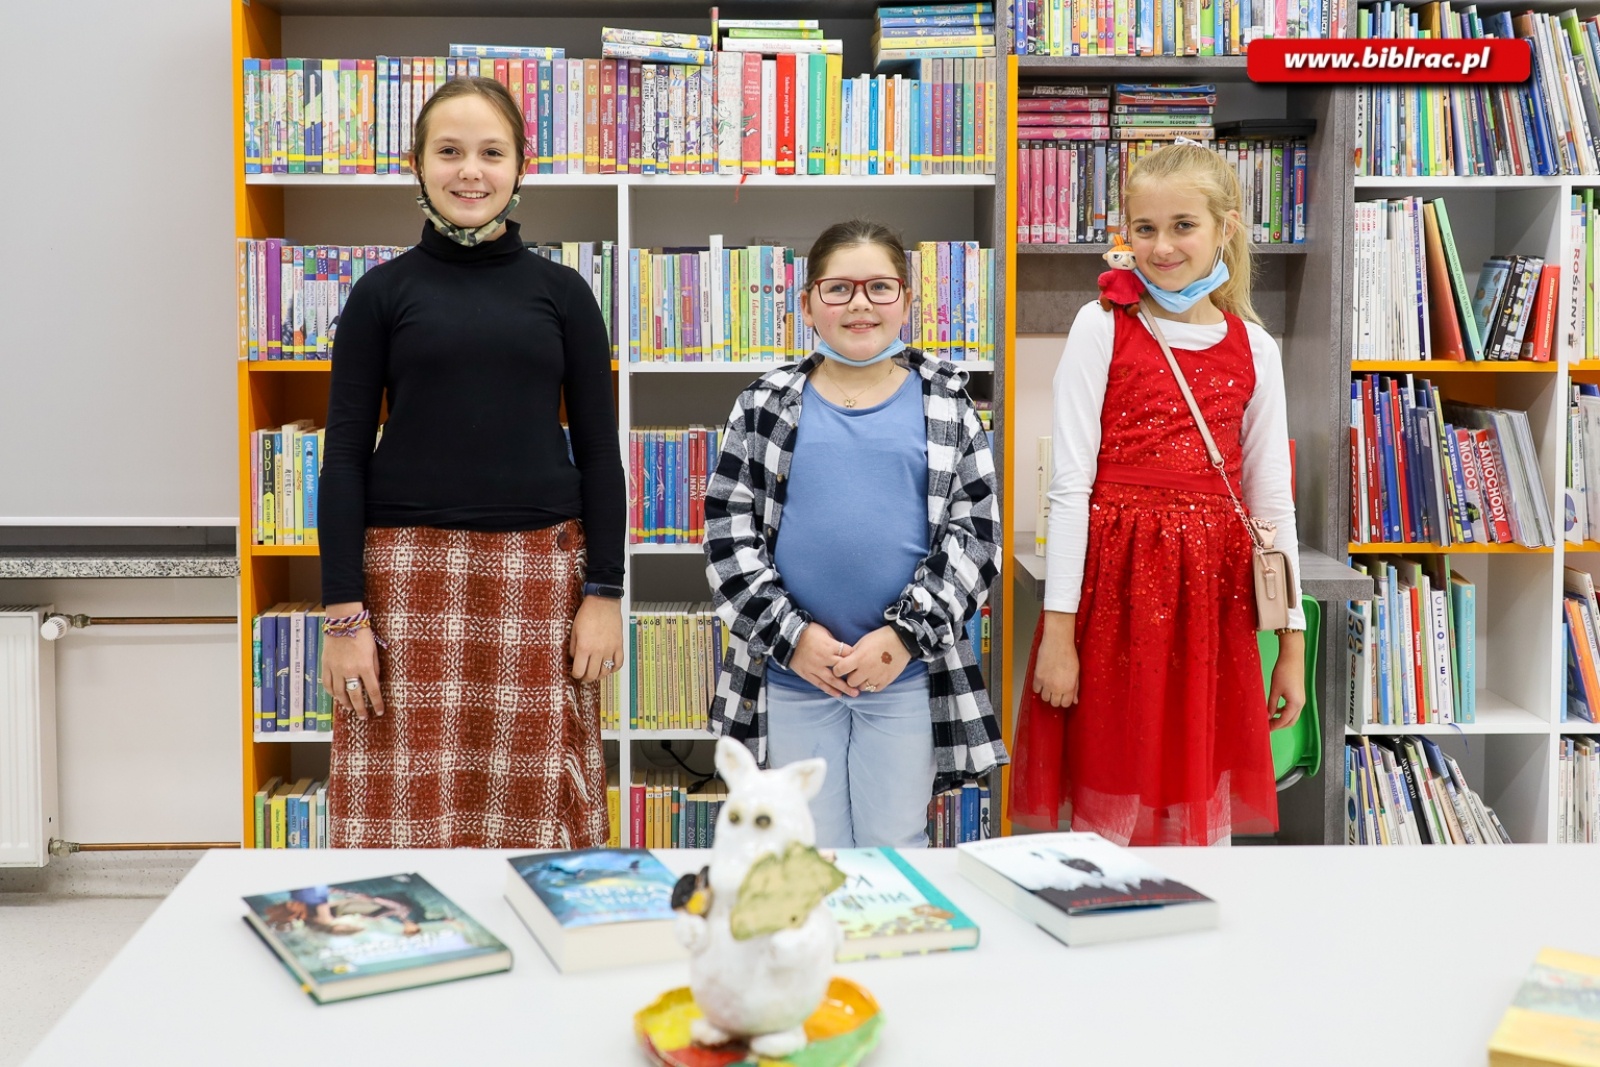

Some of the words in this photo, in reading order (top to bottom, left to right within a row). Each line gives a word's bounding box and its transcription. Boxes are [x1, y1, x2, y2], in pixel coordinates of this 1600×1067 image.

[1570, 248, 1581, 330] ROŚLINY
[264, 440, 272, 481] BUDI
[1478, 440, 1506, 522] SAMOCHODY
[1456, 484, 1468, 521] POJAZDÓW
[1348, 654, 1356, 726] CZŁOWIEK
[1401, 758, 1413, 784] OCEANY
